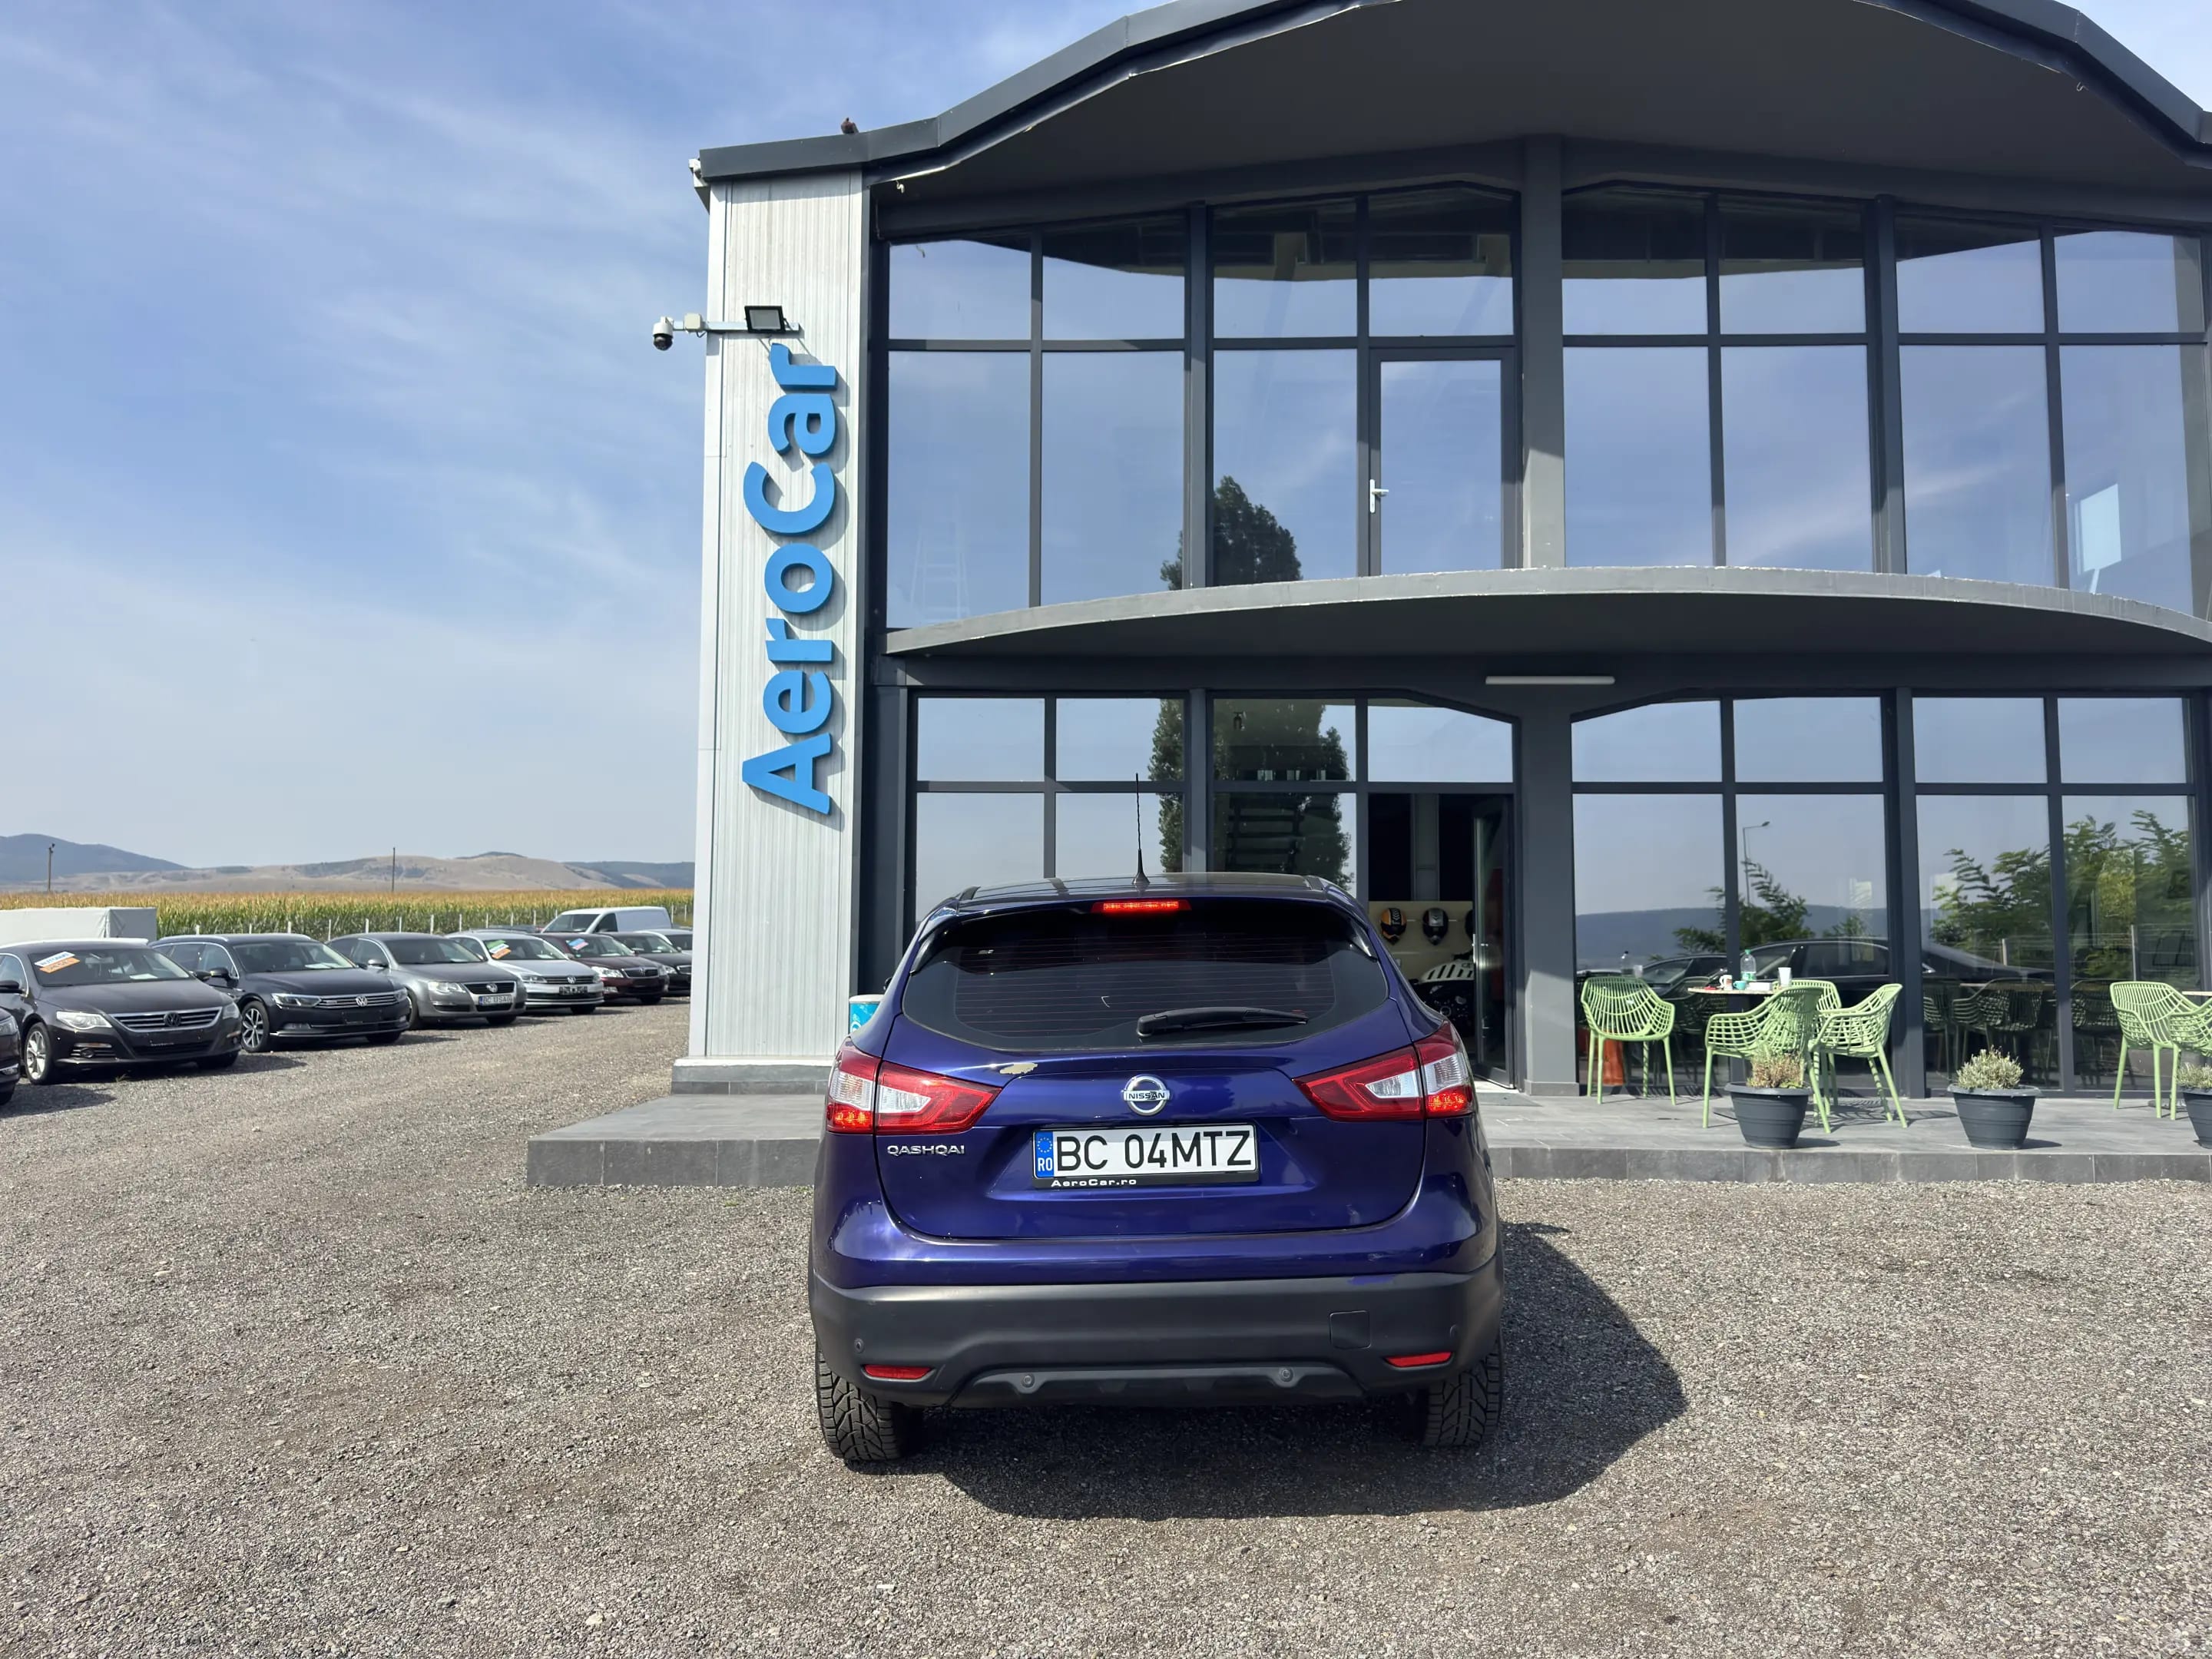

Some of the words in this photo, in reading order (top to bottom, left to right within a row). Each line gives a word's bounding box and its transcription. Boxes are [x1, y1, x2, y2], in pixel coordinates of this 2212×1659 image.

[742, 343, 837, 815] AeroCar
[887, 1144, 965, 1157] QASHQAI
[1056, 1134, 1108, 1172] BC
[1038, 1157, 1053, 1172] RO
[1051, 1178, 1137, 1187] AeroCar.ro
